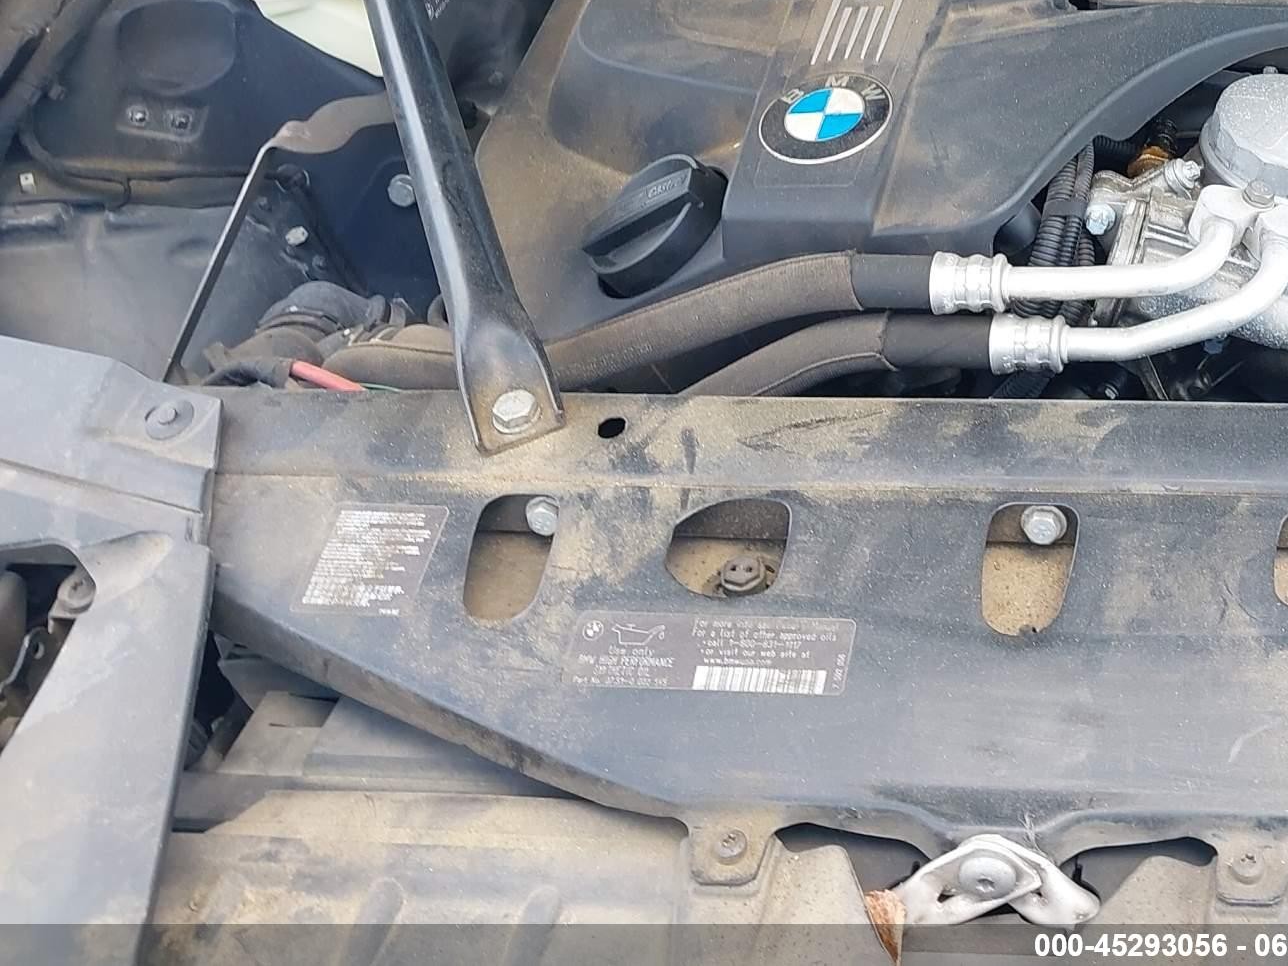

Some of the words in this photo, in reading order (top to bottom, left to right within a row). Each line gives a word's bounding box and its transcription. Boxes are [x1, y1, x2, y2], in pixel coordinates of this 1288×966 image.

[781, 75, 886, 104] BMW
[720, 628, 735, 639] list
[753, 629, 776, 640] other
[780, 631, 817, 643] approved
[632, 647, 656, 657] only
[719, 647, 738, 656] visit
[761, 649, 776, 658] web
[620, 656, 676, 668] PERFORMANCE
